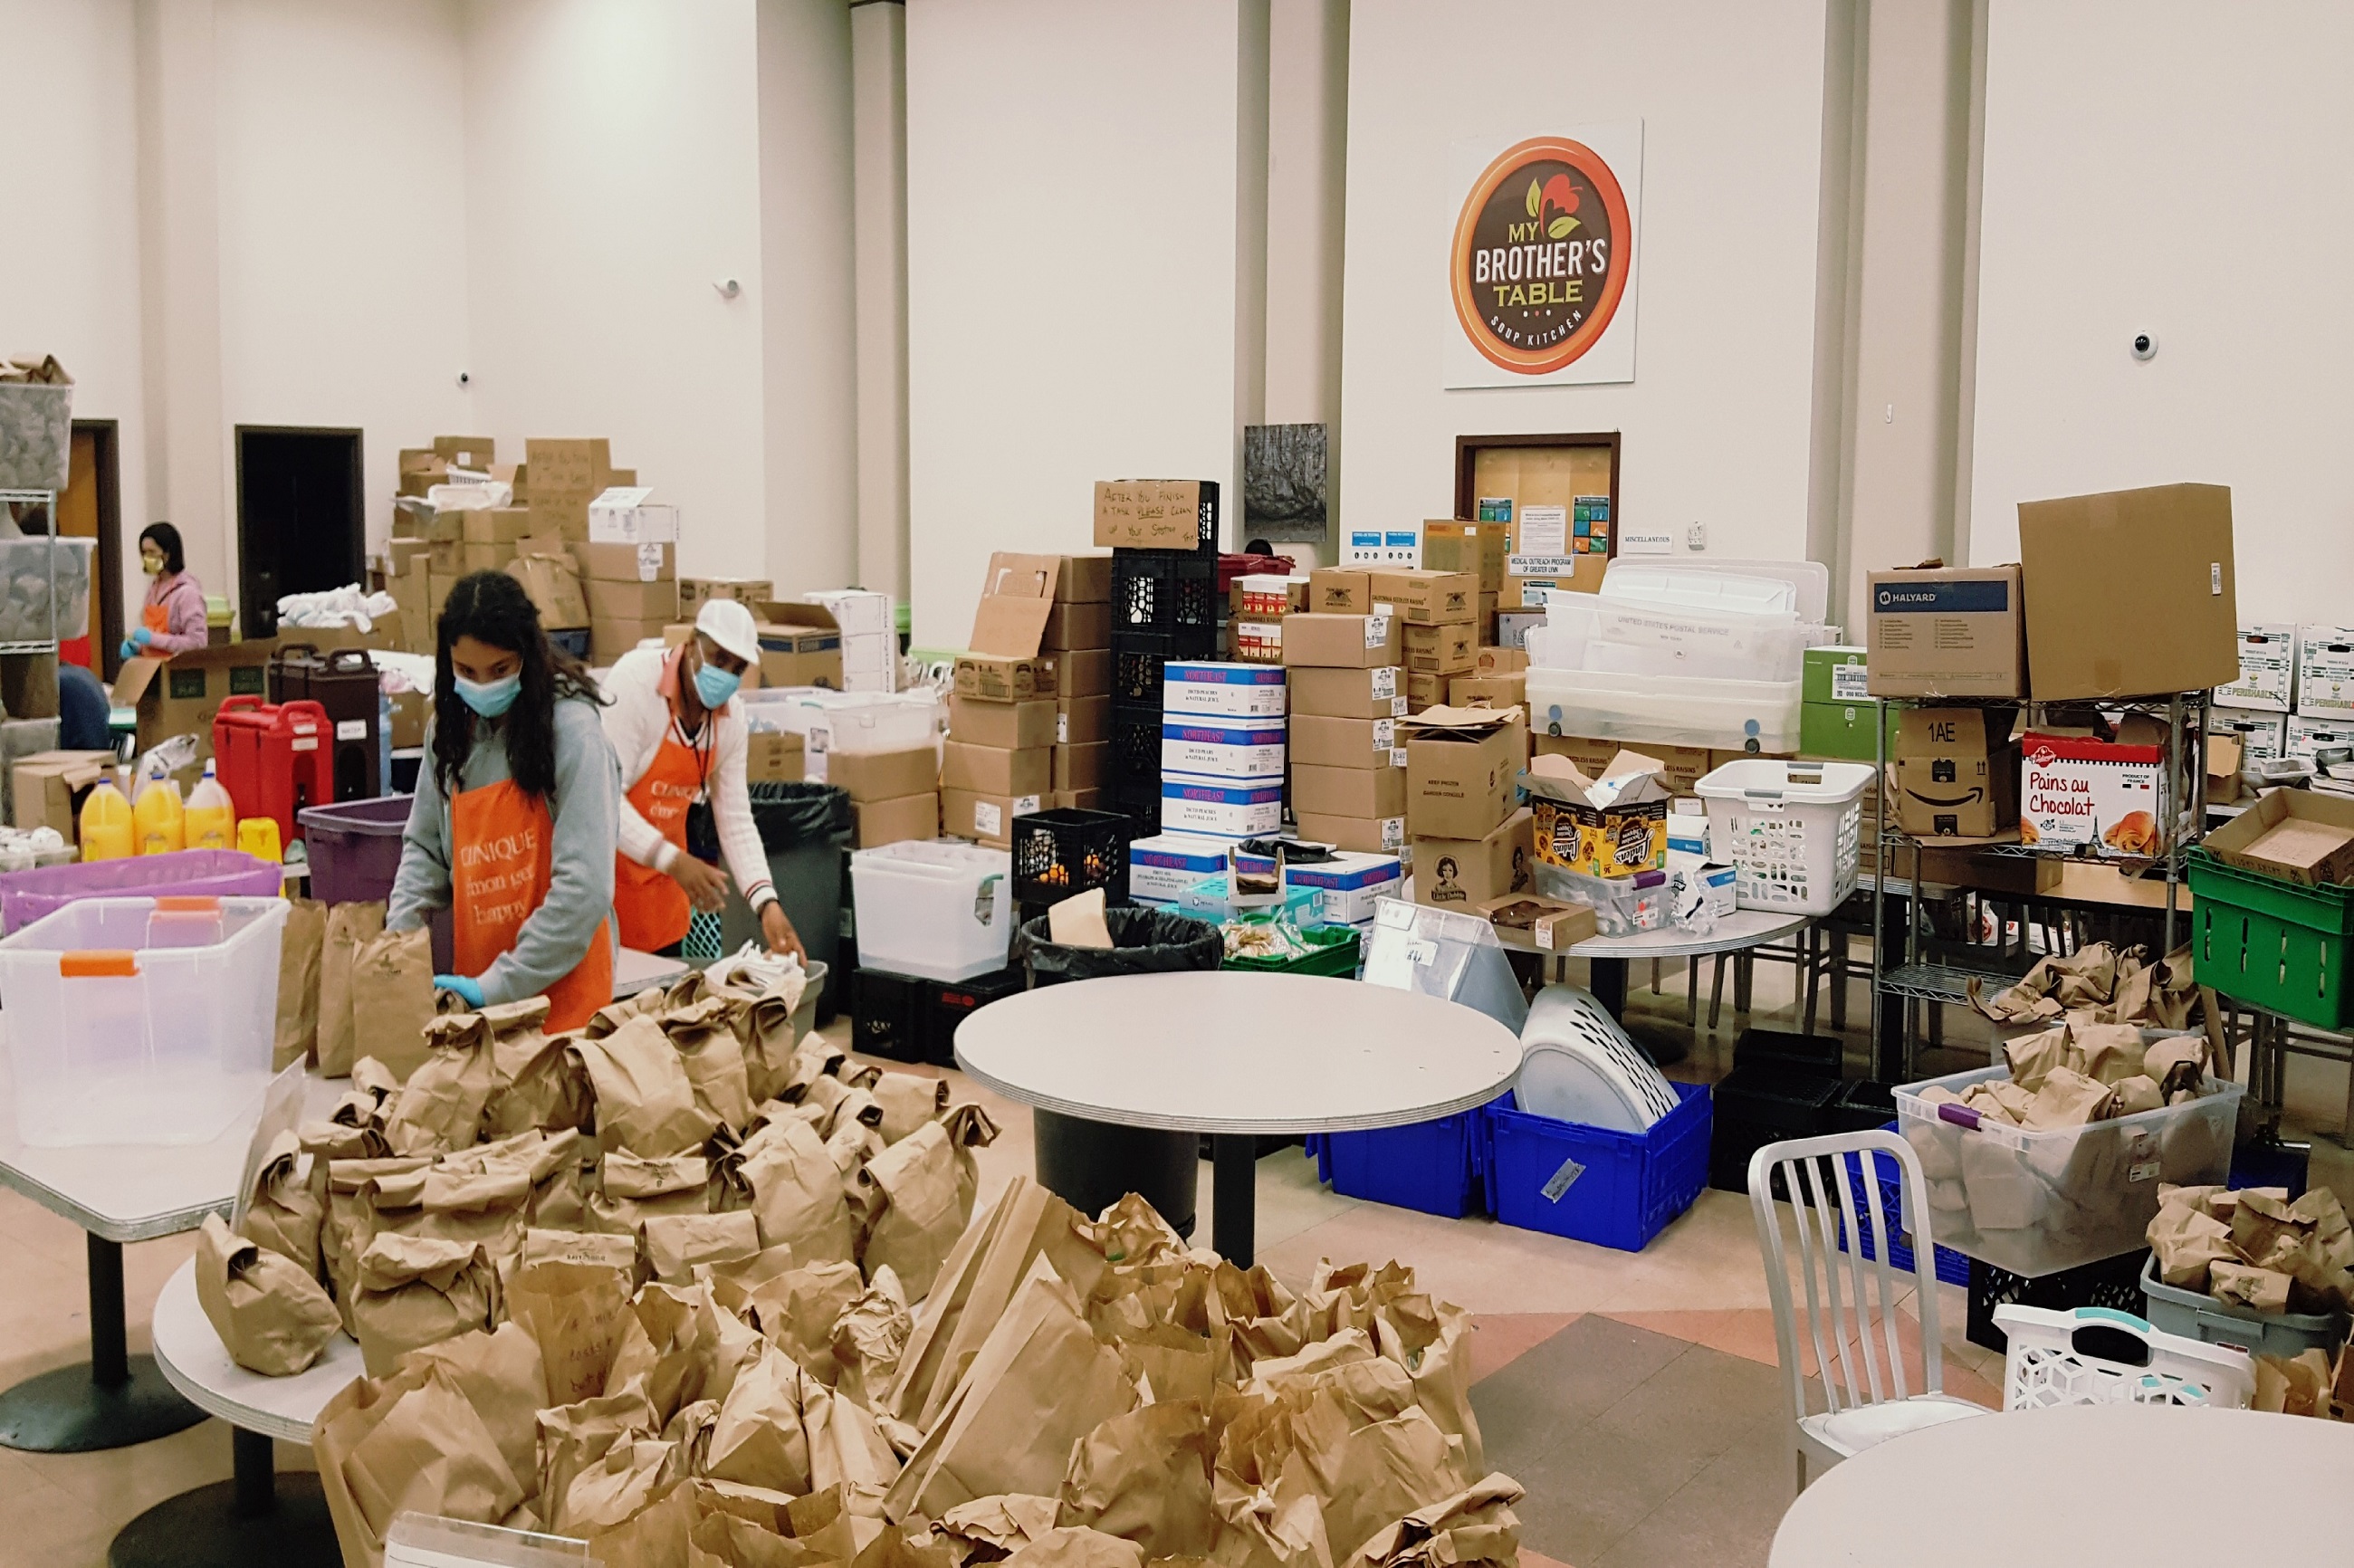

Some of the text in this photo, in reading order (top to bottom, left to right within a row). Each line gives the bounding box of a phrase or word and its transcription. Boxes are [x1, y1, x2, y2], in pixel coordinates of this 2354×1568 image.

[1508, 222, 1538, 243] MY
[1476, 238, 1606, 283] BROTHER'S
[1493, 279, 1584, 307] TABLE
[1490, 309, 1583, 346] SOUP KITCHEN
[1104, 488, 1132, 502] AFTER
[1160, 491, 1184, 502] FINISH
[1137, 508, 1164, 517] PLEASE
[1892, 593, 1936, 602] HALYARD
[1617, 616, 1642, 626] UNITED
[1669, 623, 1695, 634] POSTAL
[1184, 670, 1227, 683] NORTHEAST
[2232, 688, 2273, 699] PERISHABLE
[1183, 729, 1225, 743] NORTHEAST
[1928, 722, 1955, 742] 1AE
[2030, 772, 2090, 793] Pains au
[1183, 788, 1225, 803] NORTHEAST
[2030, 793, 2095, 816] Chocolat
[1613, 828, 1655, 865] Linden's
[1144, 854, 1187, 869] NORTHEAST
[1294, 874, 1339, 889] NORTHEAST
[1433, 890, 1465, 901] Little Debbie
